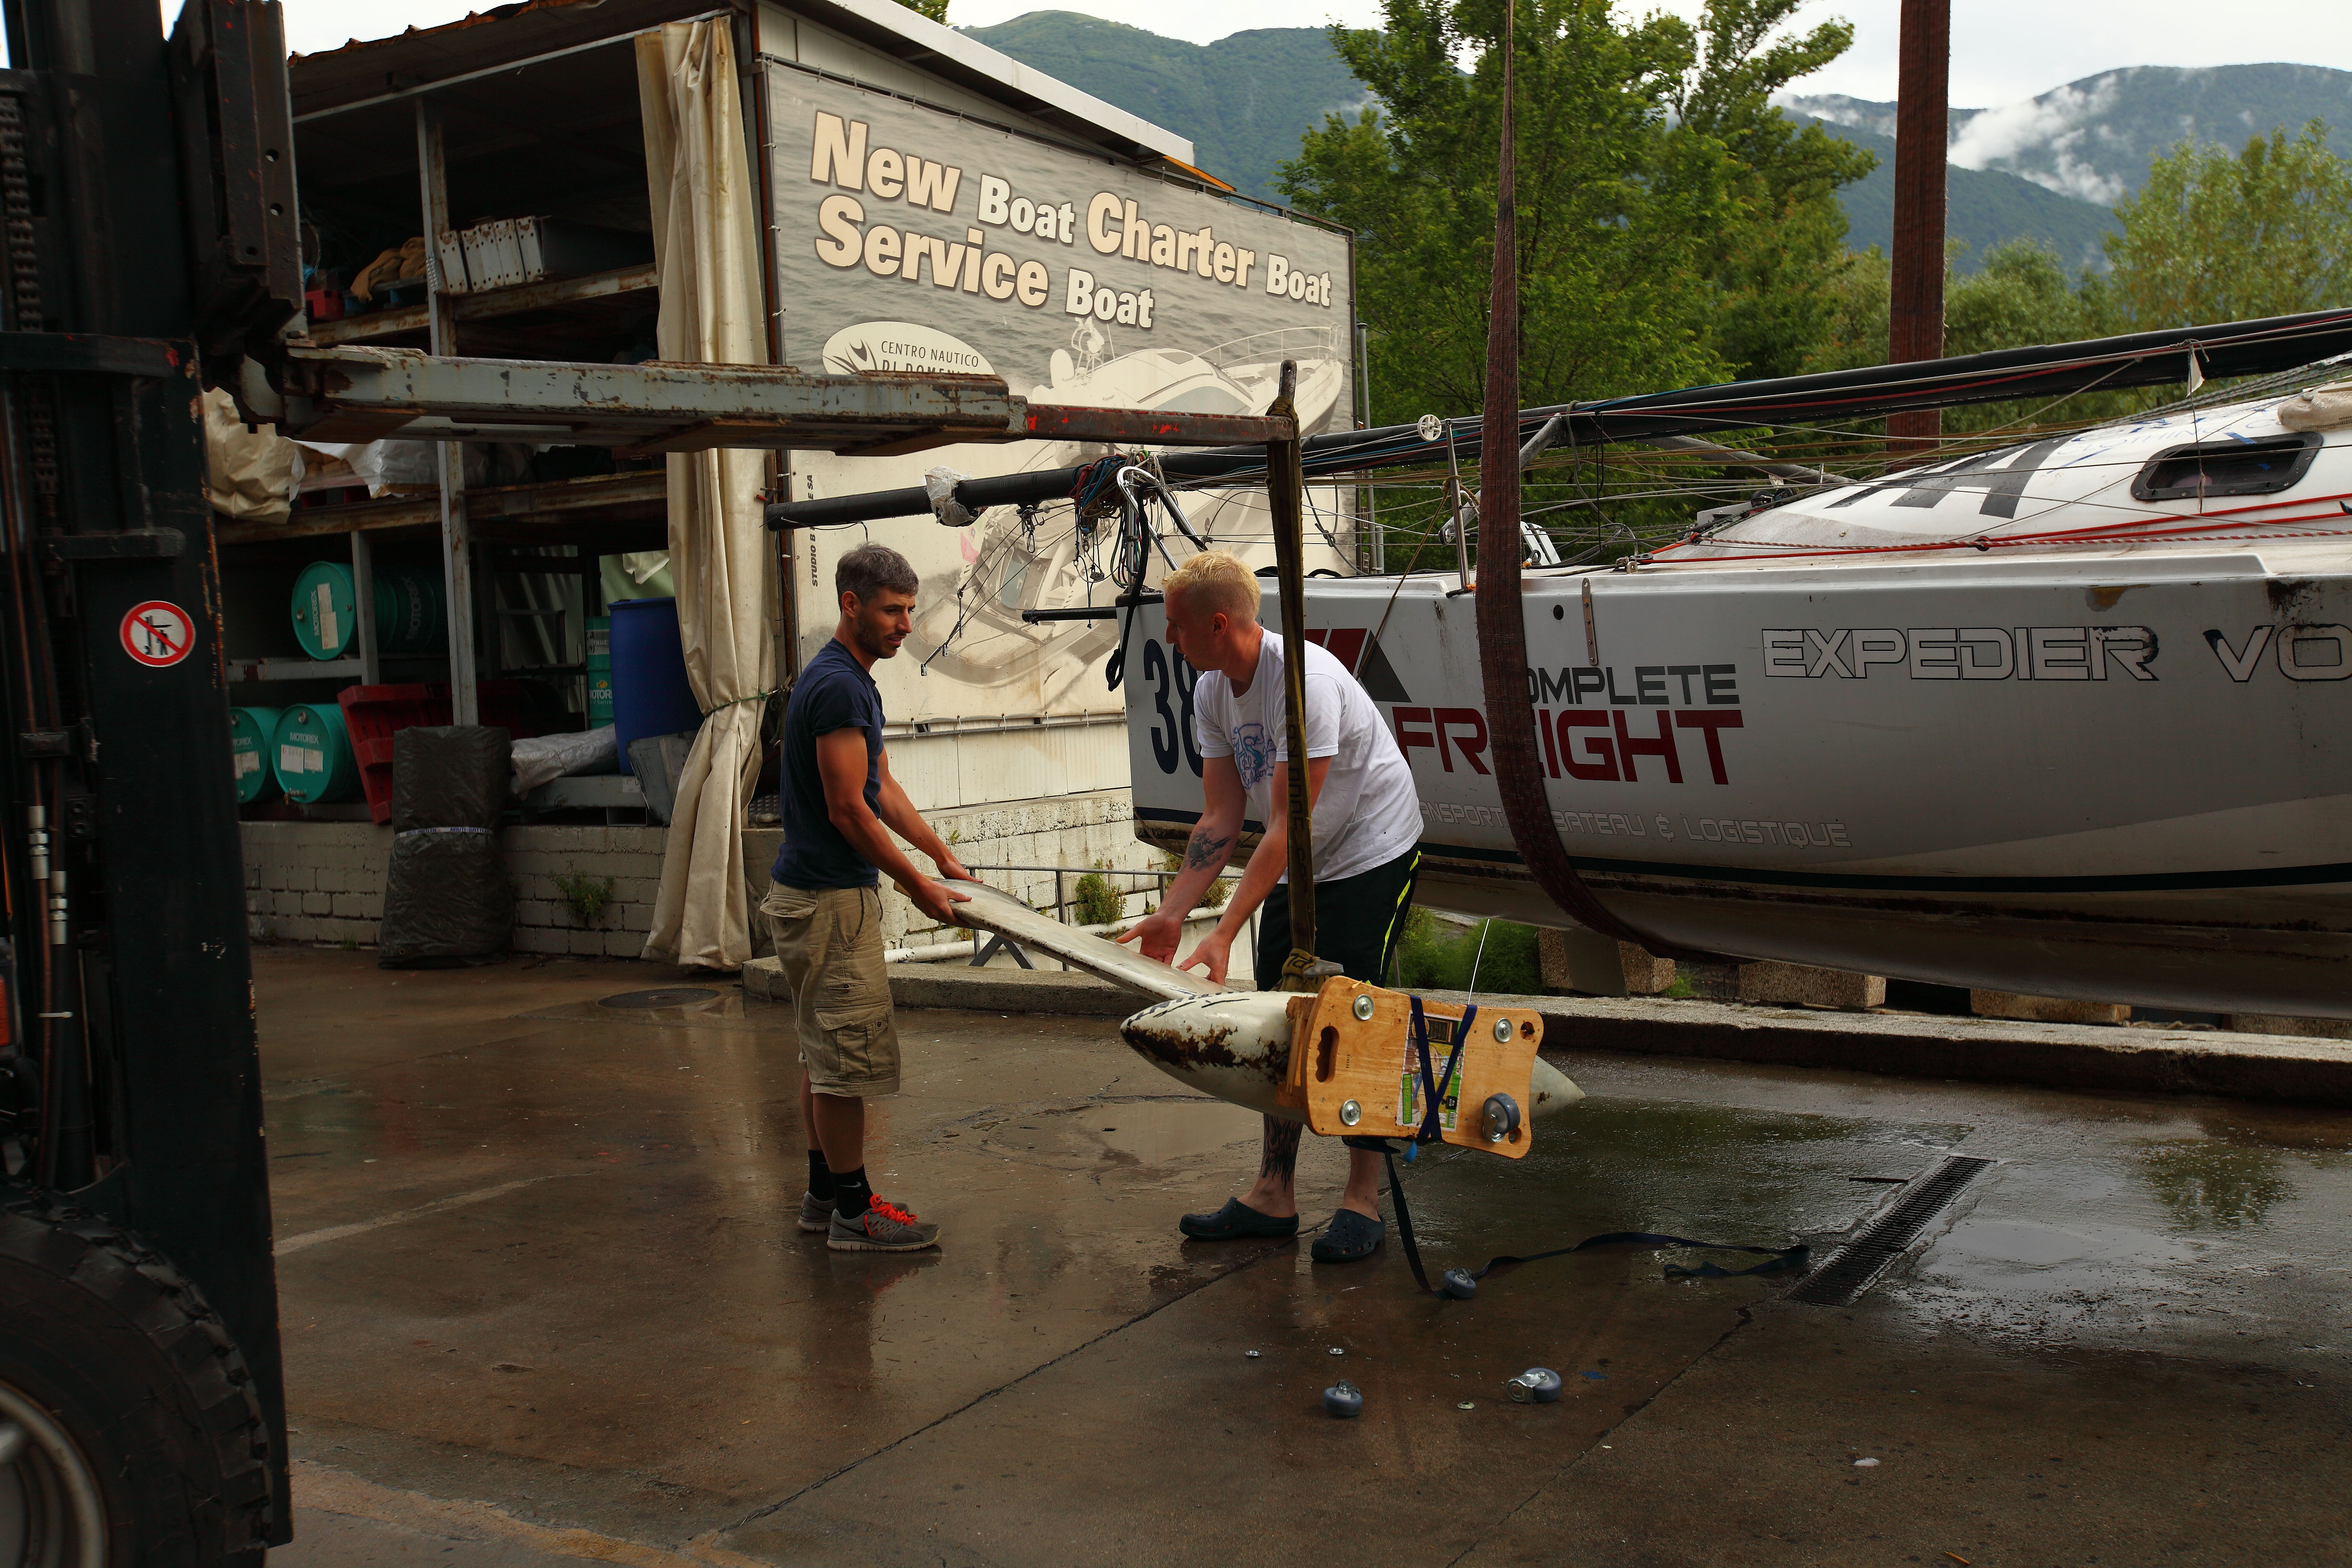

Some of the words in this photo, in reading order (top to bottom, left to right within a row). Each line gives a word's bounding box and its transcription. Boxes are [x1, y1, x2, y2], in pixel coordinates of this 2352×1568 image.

[810, 110, 962, 213] New
[978, 173, 1075, 245] Boat
[1088, 192, 1255, 288] Charter
[1266, 253, 1331, 307] Boat
[815, 194, 1048, 307] Service
[1066, 269, 1155, 328] Boat
[881, 340, 926, 358] CENTRO
[931, 348, 979, 368] NAUTICO
[807, 475, 813, 490] SA
[310, 590, 320, 636] MOTOREX
[1762, 626, 2159, 681] EXPEDIER
[589, 689, 613, 699] MOTOR
[1144, 639, 1204, 778] 38
[289, 732, 319, 744] MOTOREX
[1392, 707, 1743, 785] FRIGHT
[1419, 801, 1504, 828] ANSPORT
[1554, 810, 1646, 837] BATEAU
[1655, 812, 1675, 843] &
[1684, 818, 1852, 848] LOGISTIQUE
